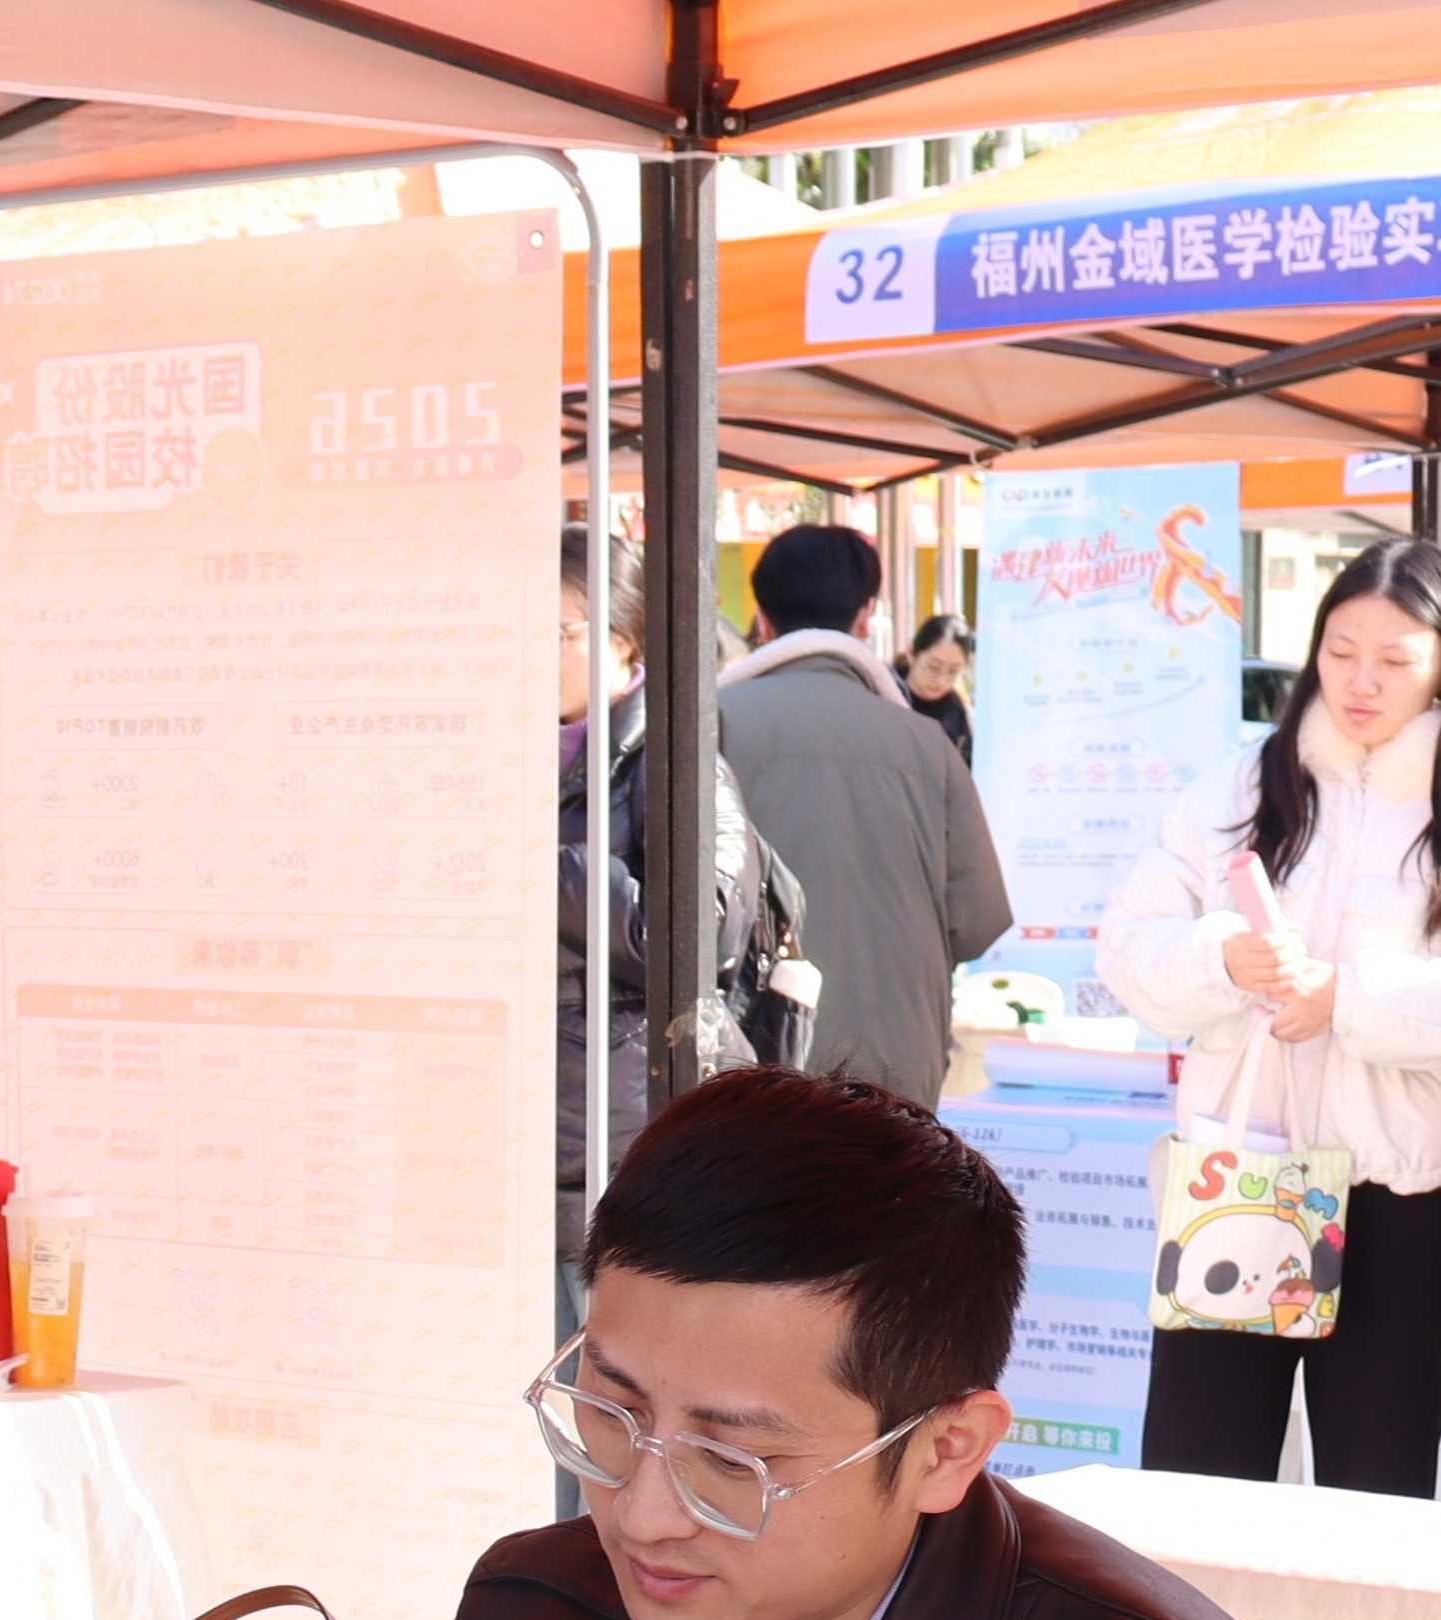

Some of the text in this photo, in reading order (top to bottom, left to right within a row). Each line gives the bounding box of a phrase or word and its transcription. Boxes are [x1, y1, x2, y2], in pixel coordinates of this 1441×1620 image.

[836, 196, 1441, 303] 32 福州金域医学检验实
